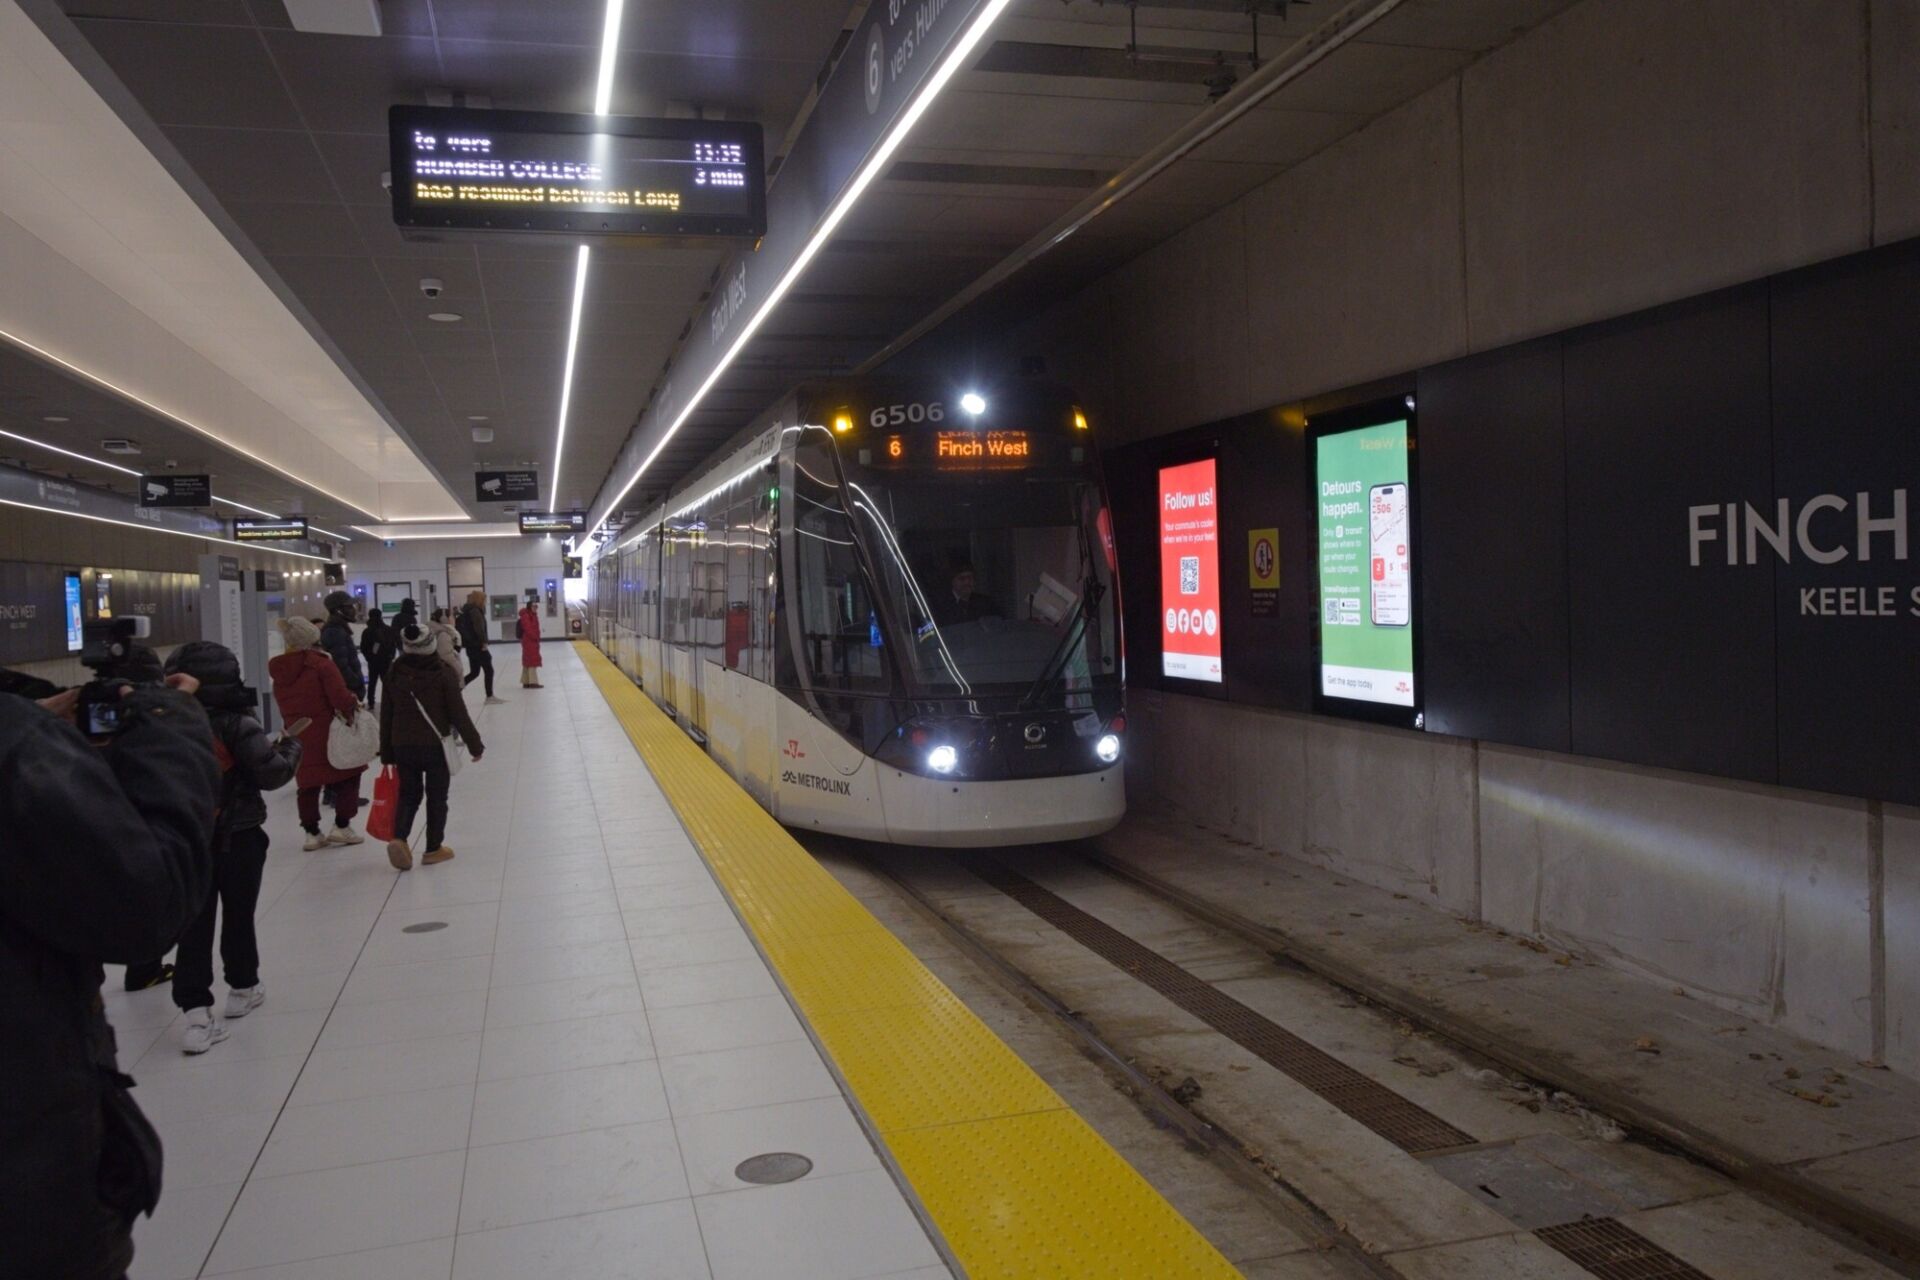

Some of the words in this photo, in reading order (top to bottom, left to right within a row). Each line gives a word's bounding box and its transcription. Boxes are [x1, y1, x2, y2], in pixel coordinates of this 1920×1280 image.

[890, 30, 913, 82] vers
[634, 191, 680, 211] Long
[869, 402, 944, 428] 6506
[889, 439, 901, 456] 6
[938, 439, 982, 456] Finch
[987, 440, 1028, 456] West
[1164, 492, 1196, 510] Follow
[1198, 487, 1213, 506] us!
[1322, 480, 1362, 496] Detours
[1322, 501, 1363, 519] happen.
[1689, 488, 1908, 566] FINCH
[1800, 587, 1897, 616] KEELE
[798, 773, 851, 796] METROLINX
